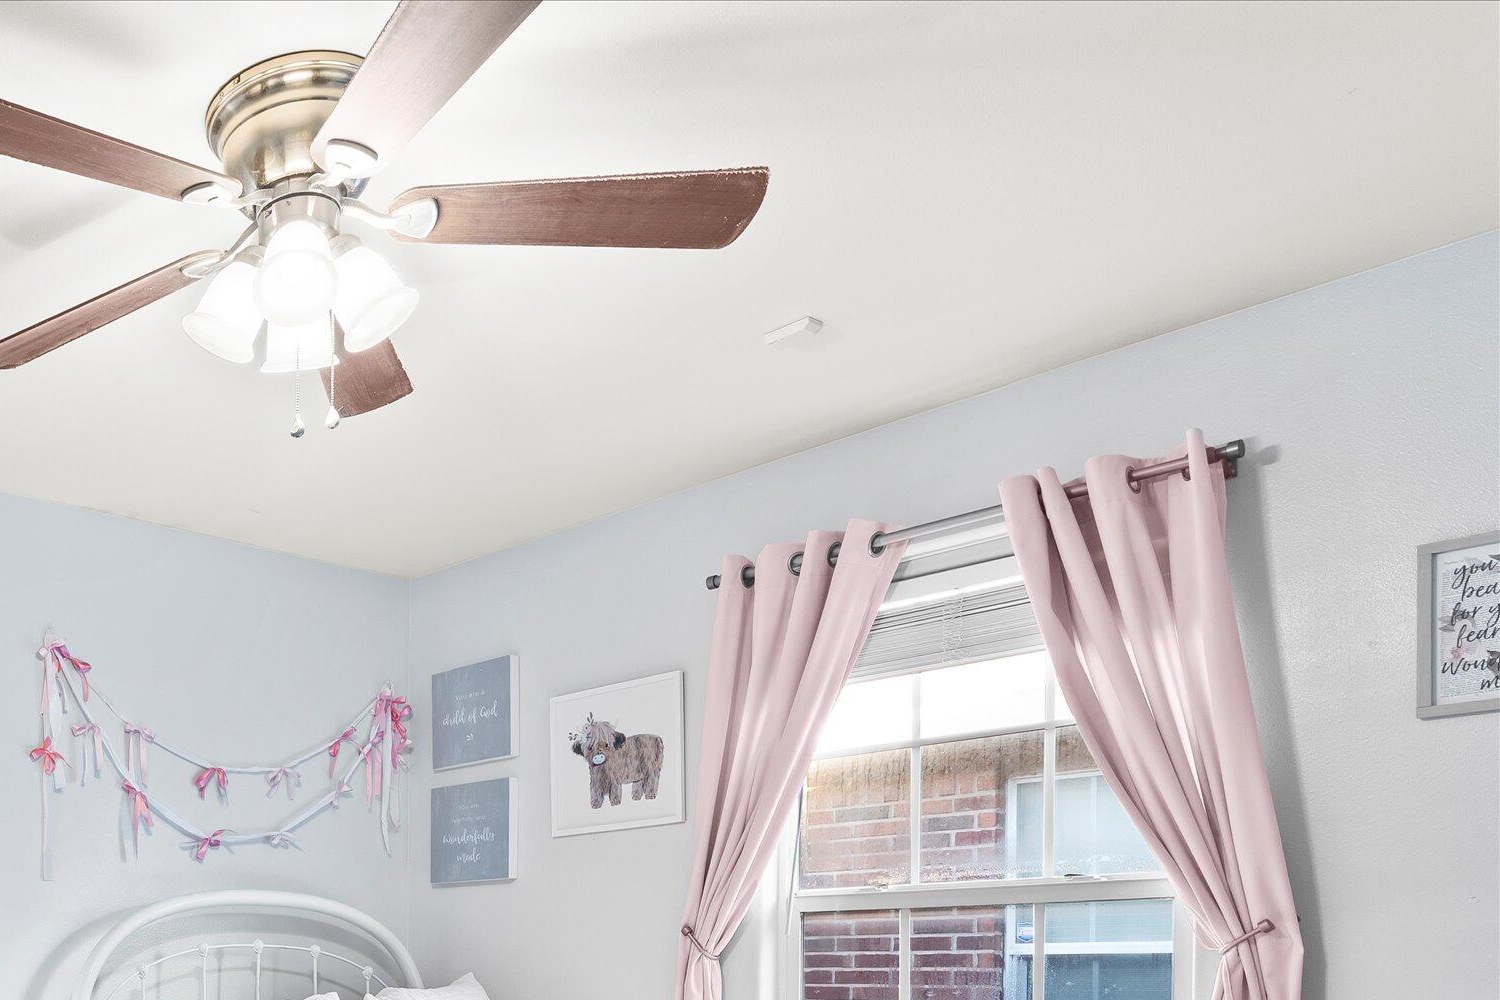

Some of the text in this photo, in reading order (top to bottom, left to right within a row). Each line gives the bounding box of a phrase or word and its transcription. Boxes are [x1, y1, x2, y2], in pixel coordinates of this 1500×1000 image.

[1452, 559, 1498, 589] you
[1451, 602, 1483, 626] for
[468, 706, 478, 724] of
[479, 699, 500, 719] God
[456, 847, 481, 863] made
